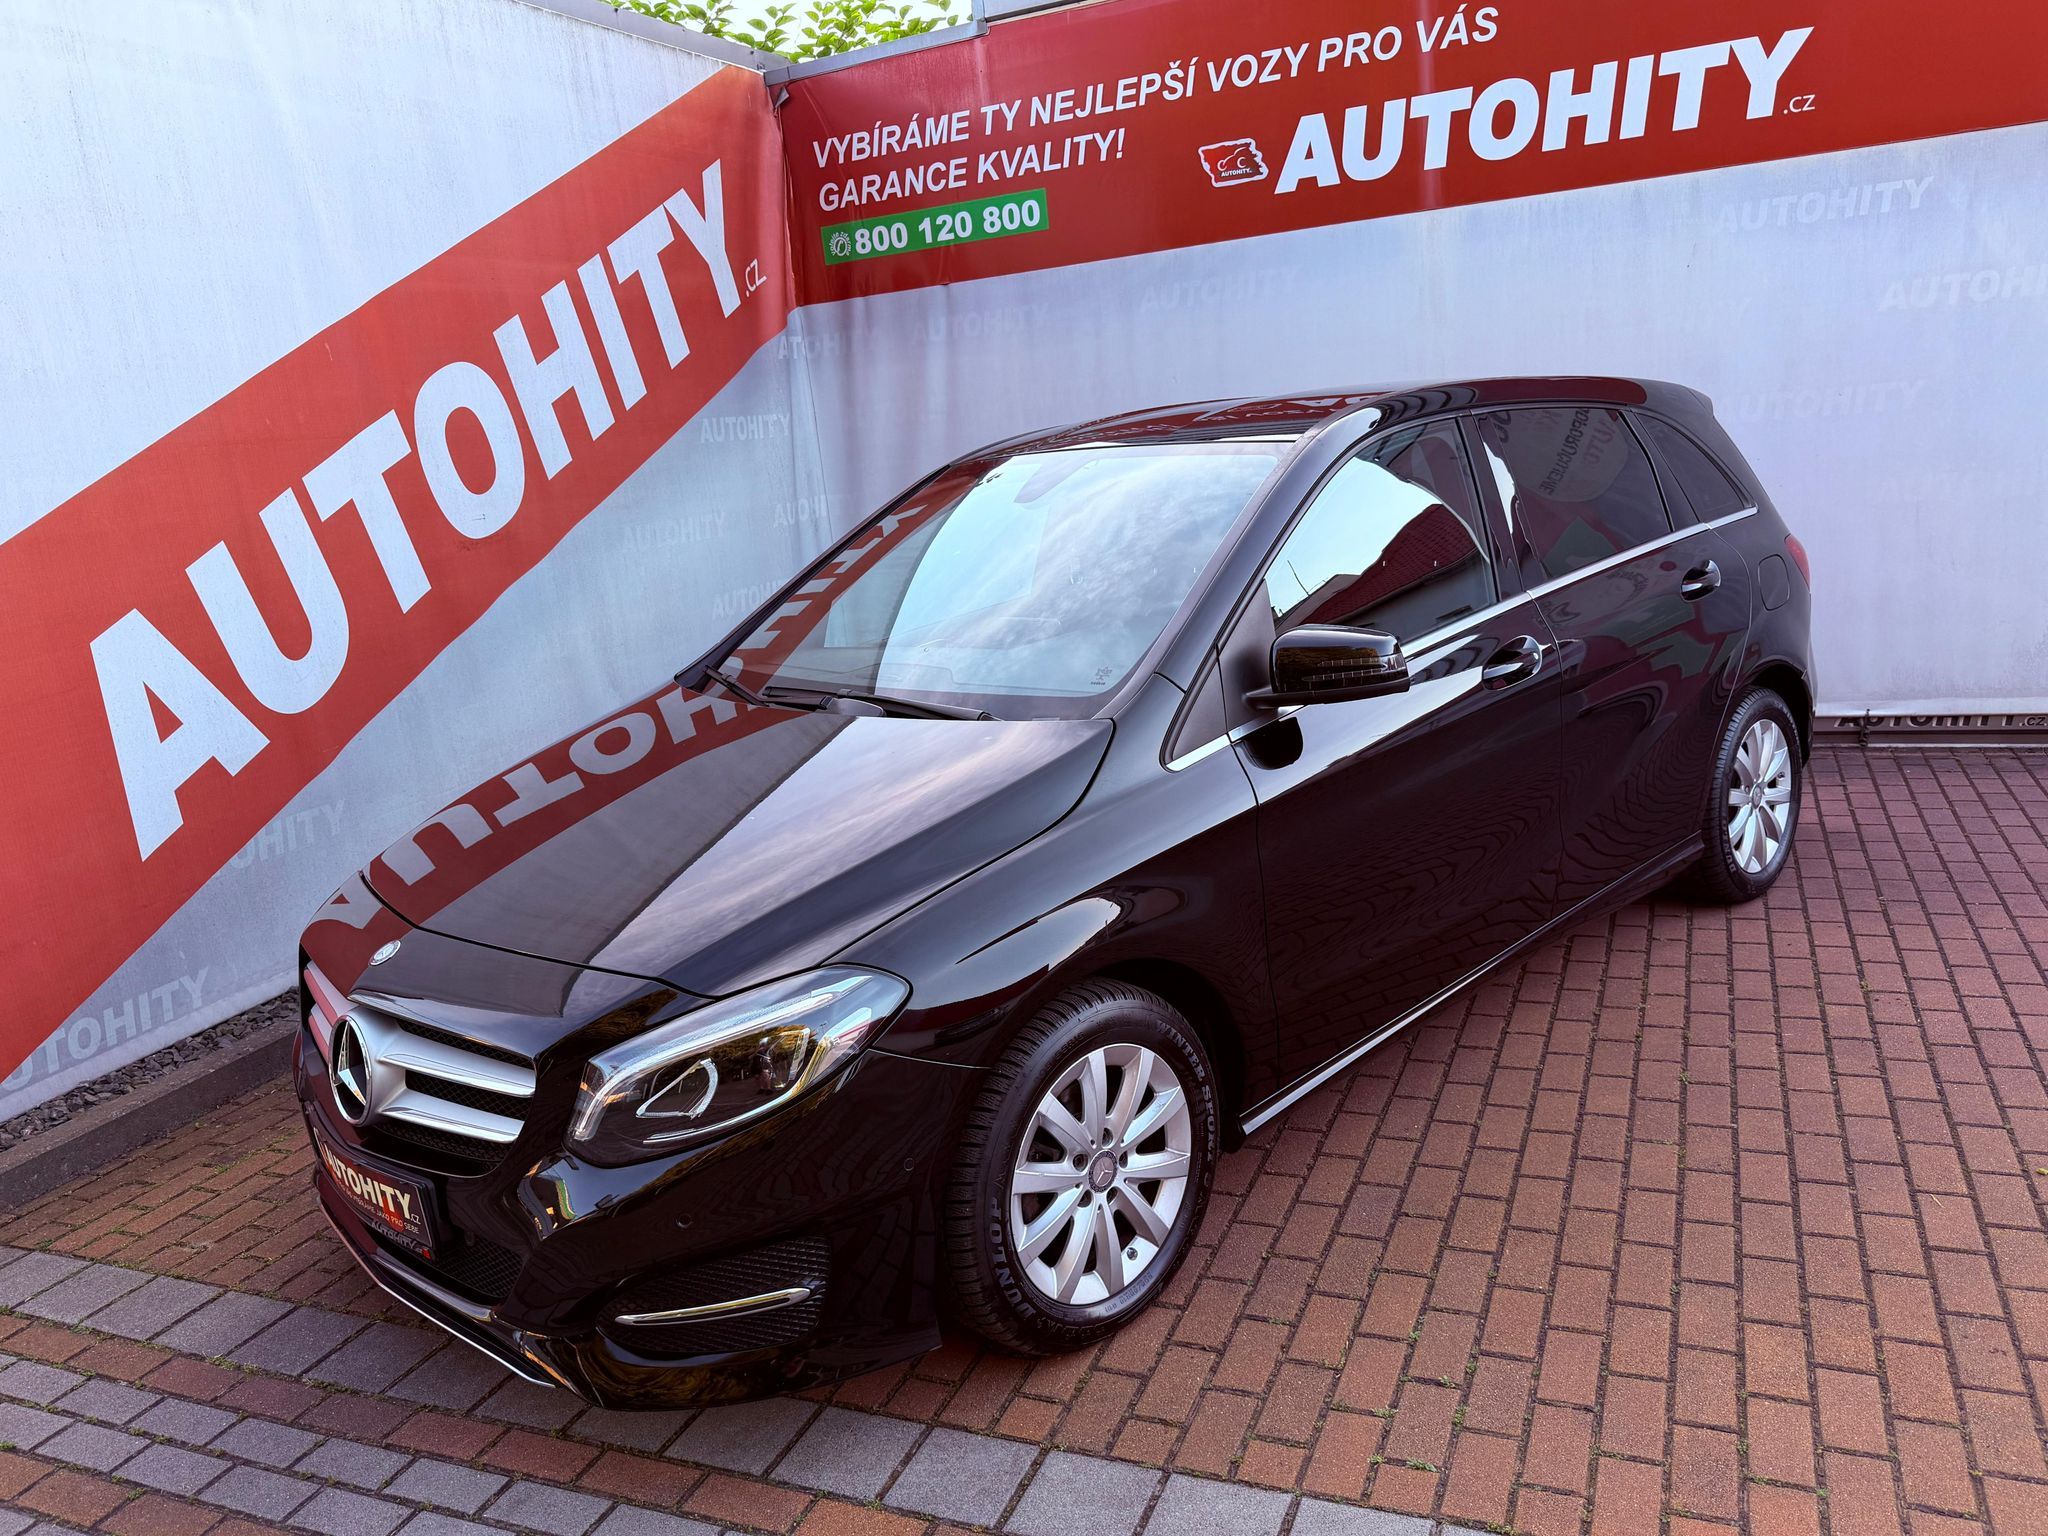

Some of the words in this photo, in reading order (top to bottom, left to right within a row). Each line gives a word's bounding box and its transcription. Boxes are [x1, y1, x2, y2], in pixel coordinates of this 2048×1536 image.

[813, 110, 971, 168] VYBÍRÁME
[981, 100, 1022, 135] TY
[1029, 57, 1199, 127] NEJLEPŠÍ
[1206, 42, 1309, 93] VOZY
[1317, 26, 1402, 73] PRO
[1416, 4, 1499, 53] VÁS
[1274, 26, 1815, 195] AUTOHITY
[819, 157, 968, 212] GARANCE
[977, 128, 1126, 184] KVALITY!
[1713, 175, 1936, 235] AUTOHITY
[854, 222, 908, 254] 800
[918, 211, 972, 244] 120
[982, 199, 1040, 233] 800
[700, 412, 791, 444] AUTOHITY
[90, 159, 742, 862] AUTOHITY
[1156, 1019, 1206, 1081] WINTER
